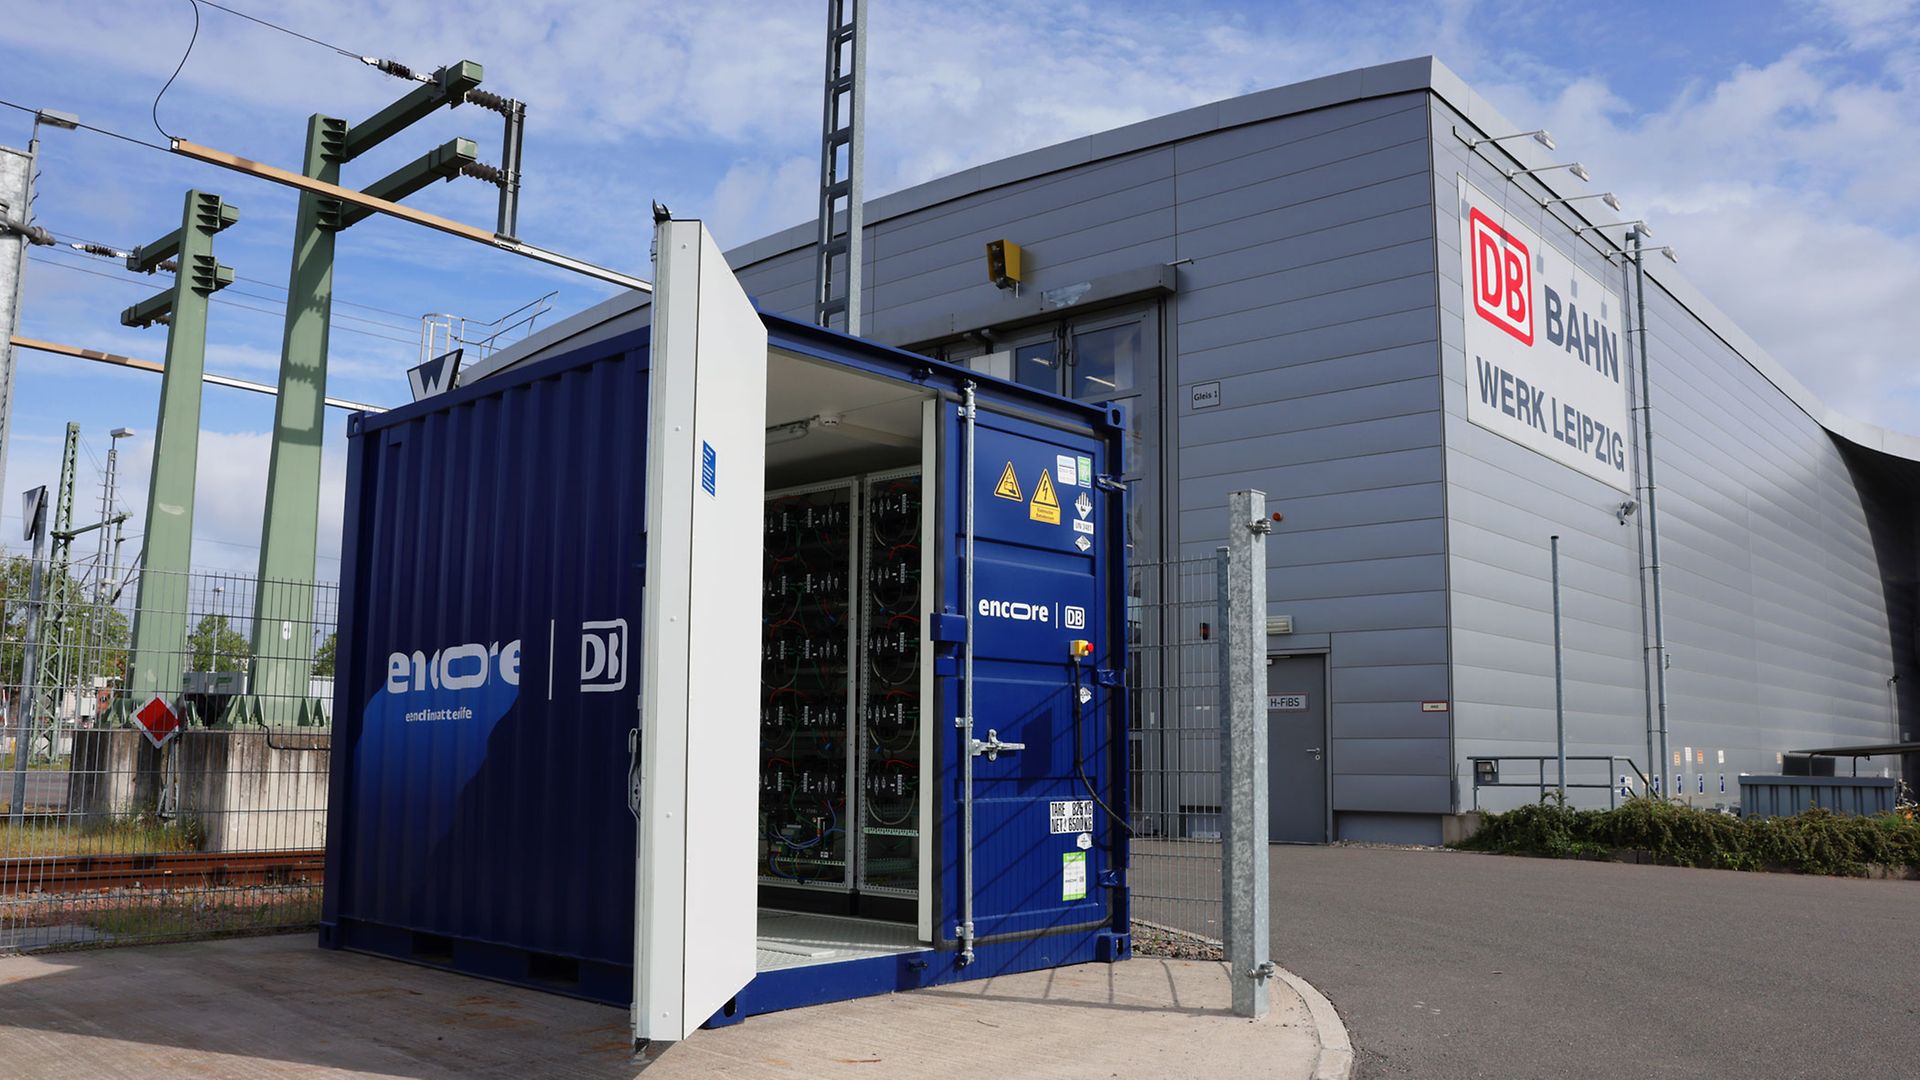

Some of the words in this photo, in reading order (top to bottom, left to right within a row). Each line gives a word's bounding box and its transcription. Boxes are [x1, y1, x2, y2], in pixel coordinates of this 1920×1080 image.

[1479, 229, 1527, 324] DB
[1544, 284, 1619, 383] BAHN
[408, 351, 458, 402] W
[1194, 391, 1212, 401] Gleis
[1476, 356, 1547, 433] WERK
[1551, 396, 1625, 472] LEIPZIG
[978, 598, 1049, 622] encore
[1051, 803, 1065, 817] TARE
